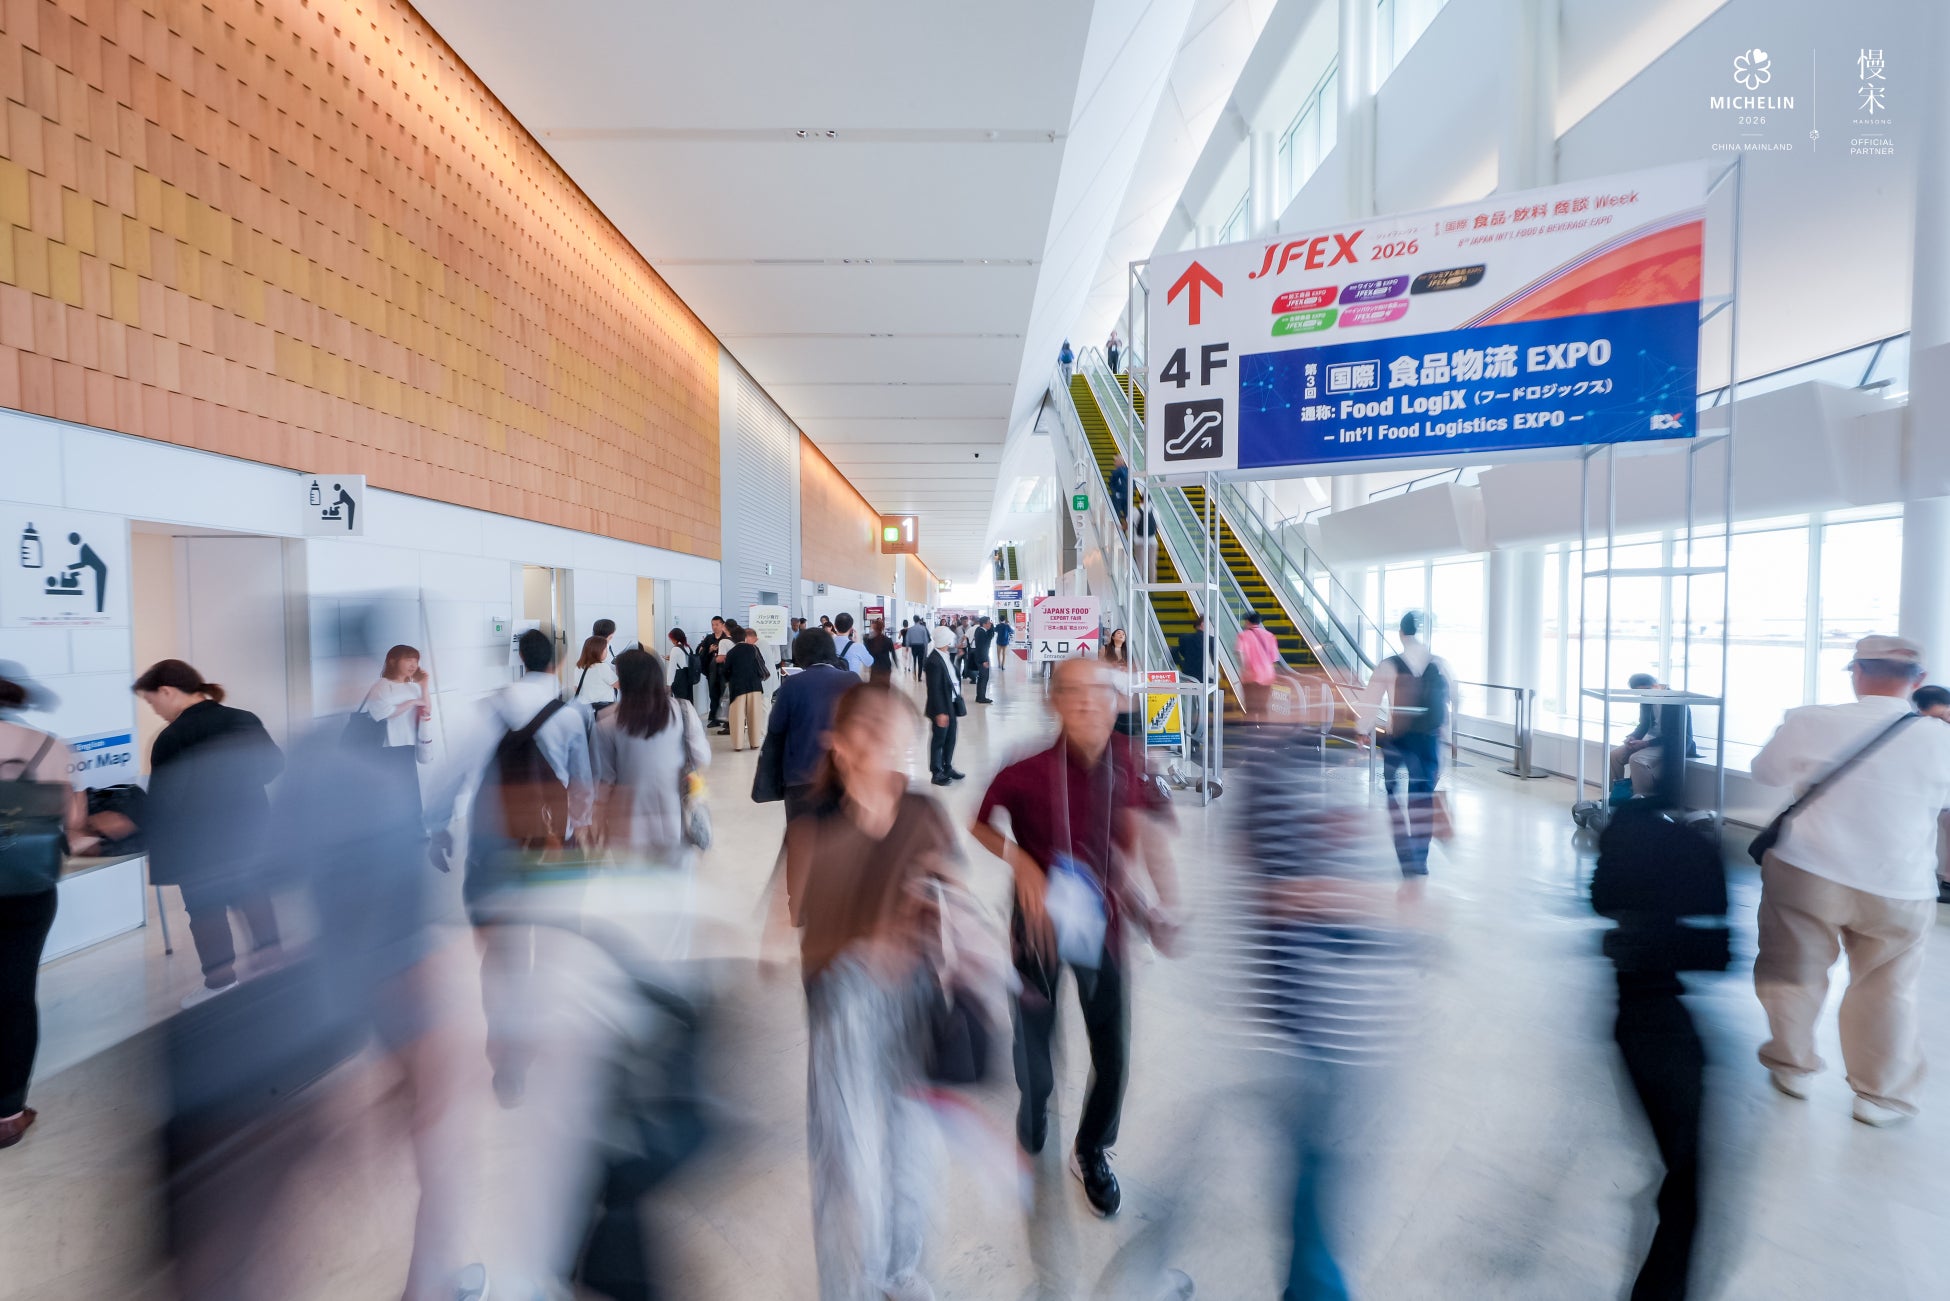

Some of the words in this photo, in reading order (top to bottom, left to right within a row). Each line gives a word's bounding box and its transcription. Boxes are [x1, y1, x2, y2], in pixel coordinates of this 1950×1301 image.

[1595, 190, 1640, 209] Week
[1248, 229, 1365, 280] JFEX
[1370, 239, 1420, 261] 2026
[1159, 342, 1230, 389] 4F
[1330, 364, 1375, 391] 国際
[1388, 344, 1519, 389] 食品物流
[1527, 338, 1612, 373] EXPO
[1304, 363, 1318, 400] 第3回
[1301, 404, 1336, 422] 通称:
[1340, 396, 1394, 420] Food
[1401, 389, 1467, 416] LogiX
[1378, 422, 1420, 441] Food
[1425, 417, 1508, 438] Logistics
[1513, 410, 1565, 430] EXPO
[1076, 500, 1085, 510] 南
[902, 517, 914, 542] 1
[944, 580, 952, 590] 2
[1040, 641, 1069, 653] 入口
[76, 741, 105, 751] English
[95, 751, 132, 769] Map
